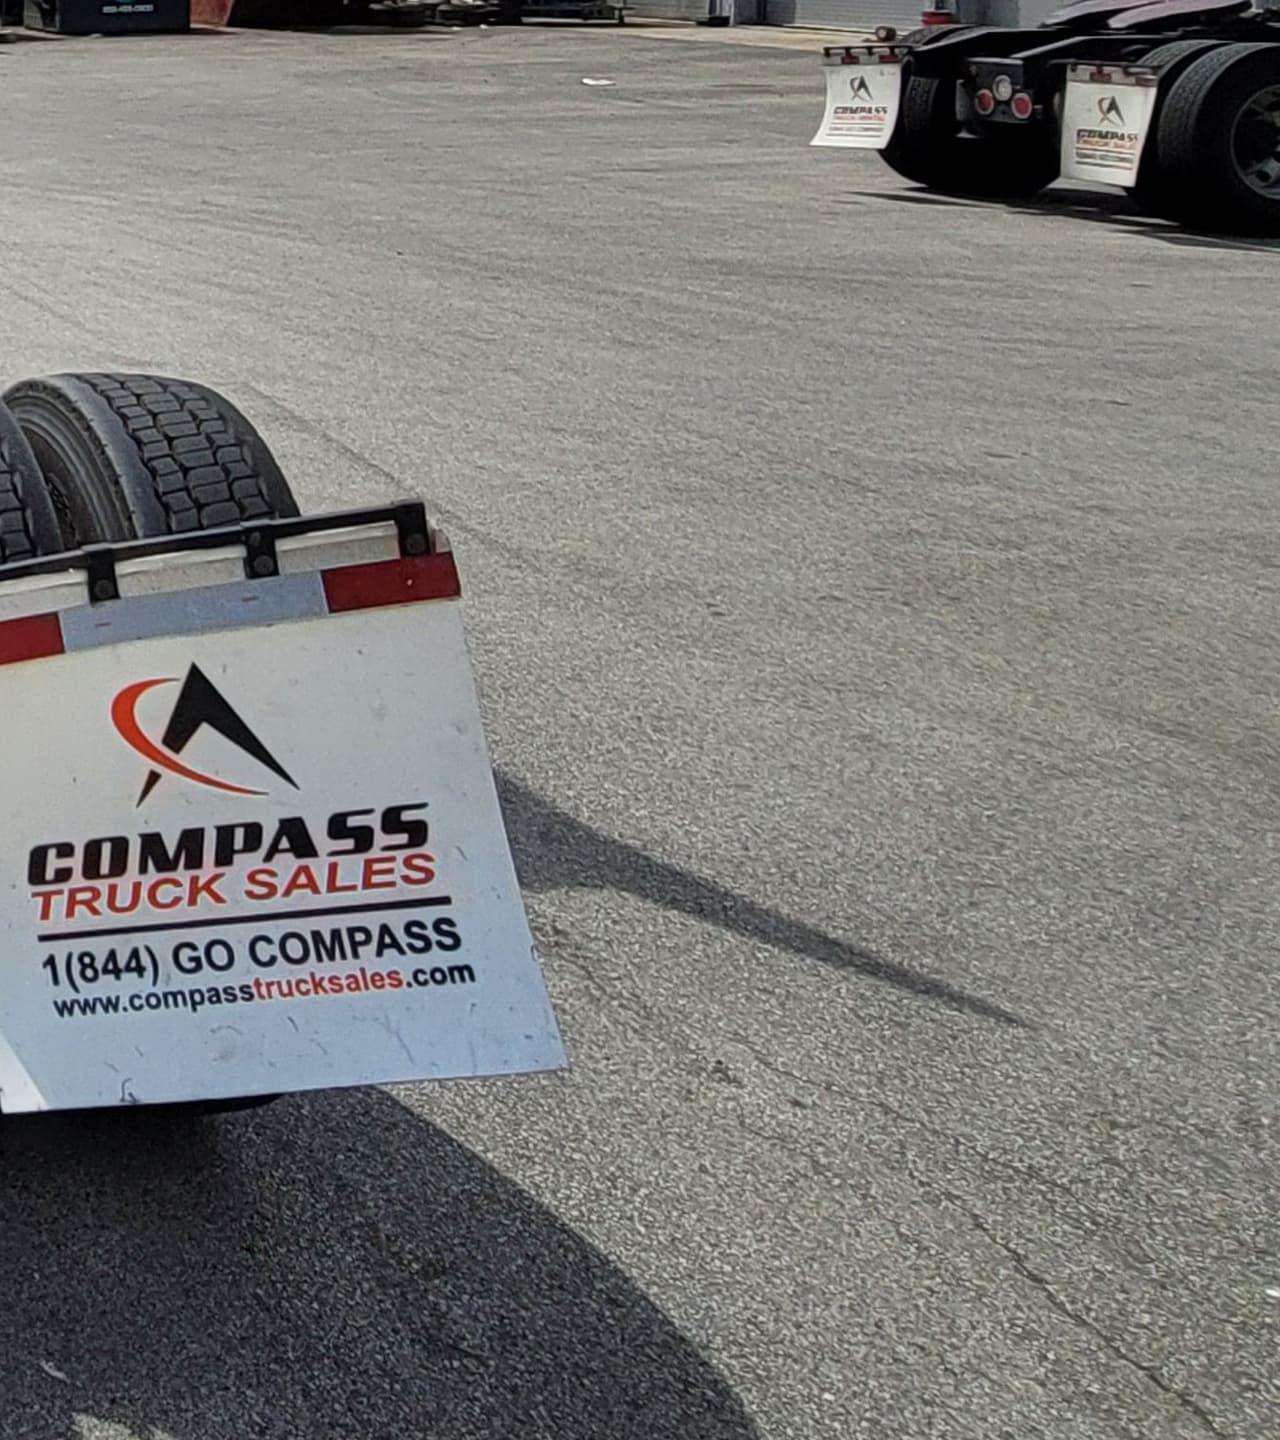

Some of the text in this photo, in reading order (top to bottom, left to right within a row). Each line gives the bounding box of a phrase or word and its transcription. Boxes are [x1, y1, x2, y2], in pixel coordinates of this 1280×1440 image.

[27, 802, 429, 886] COMPASS
[31, 852, 436, 921] TRUCK SALES
[42, 917, 462, 993] 1(844) GO COMPASS
[53, 962, 476, 1018] www.compasstrucksales.com
